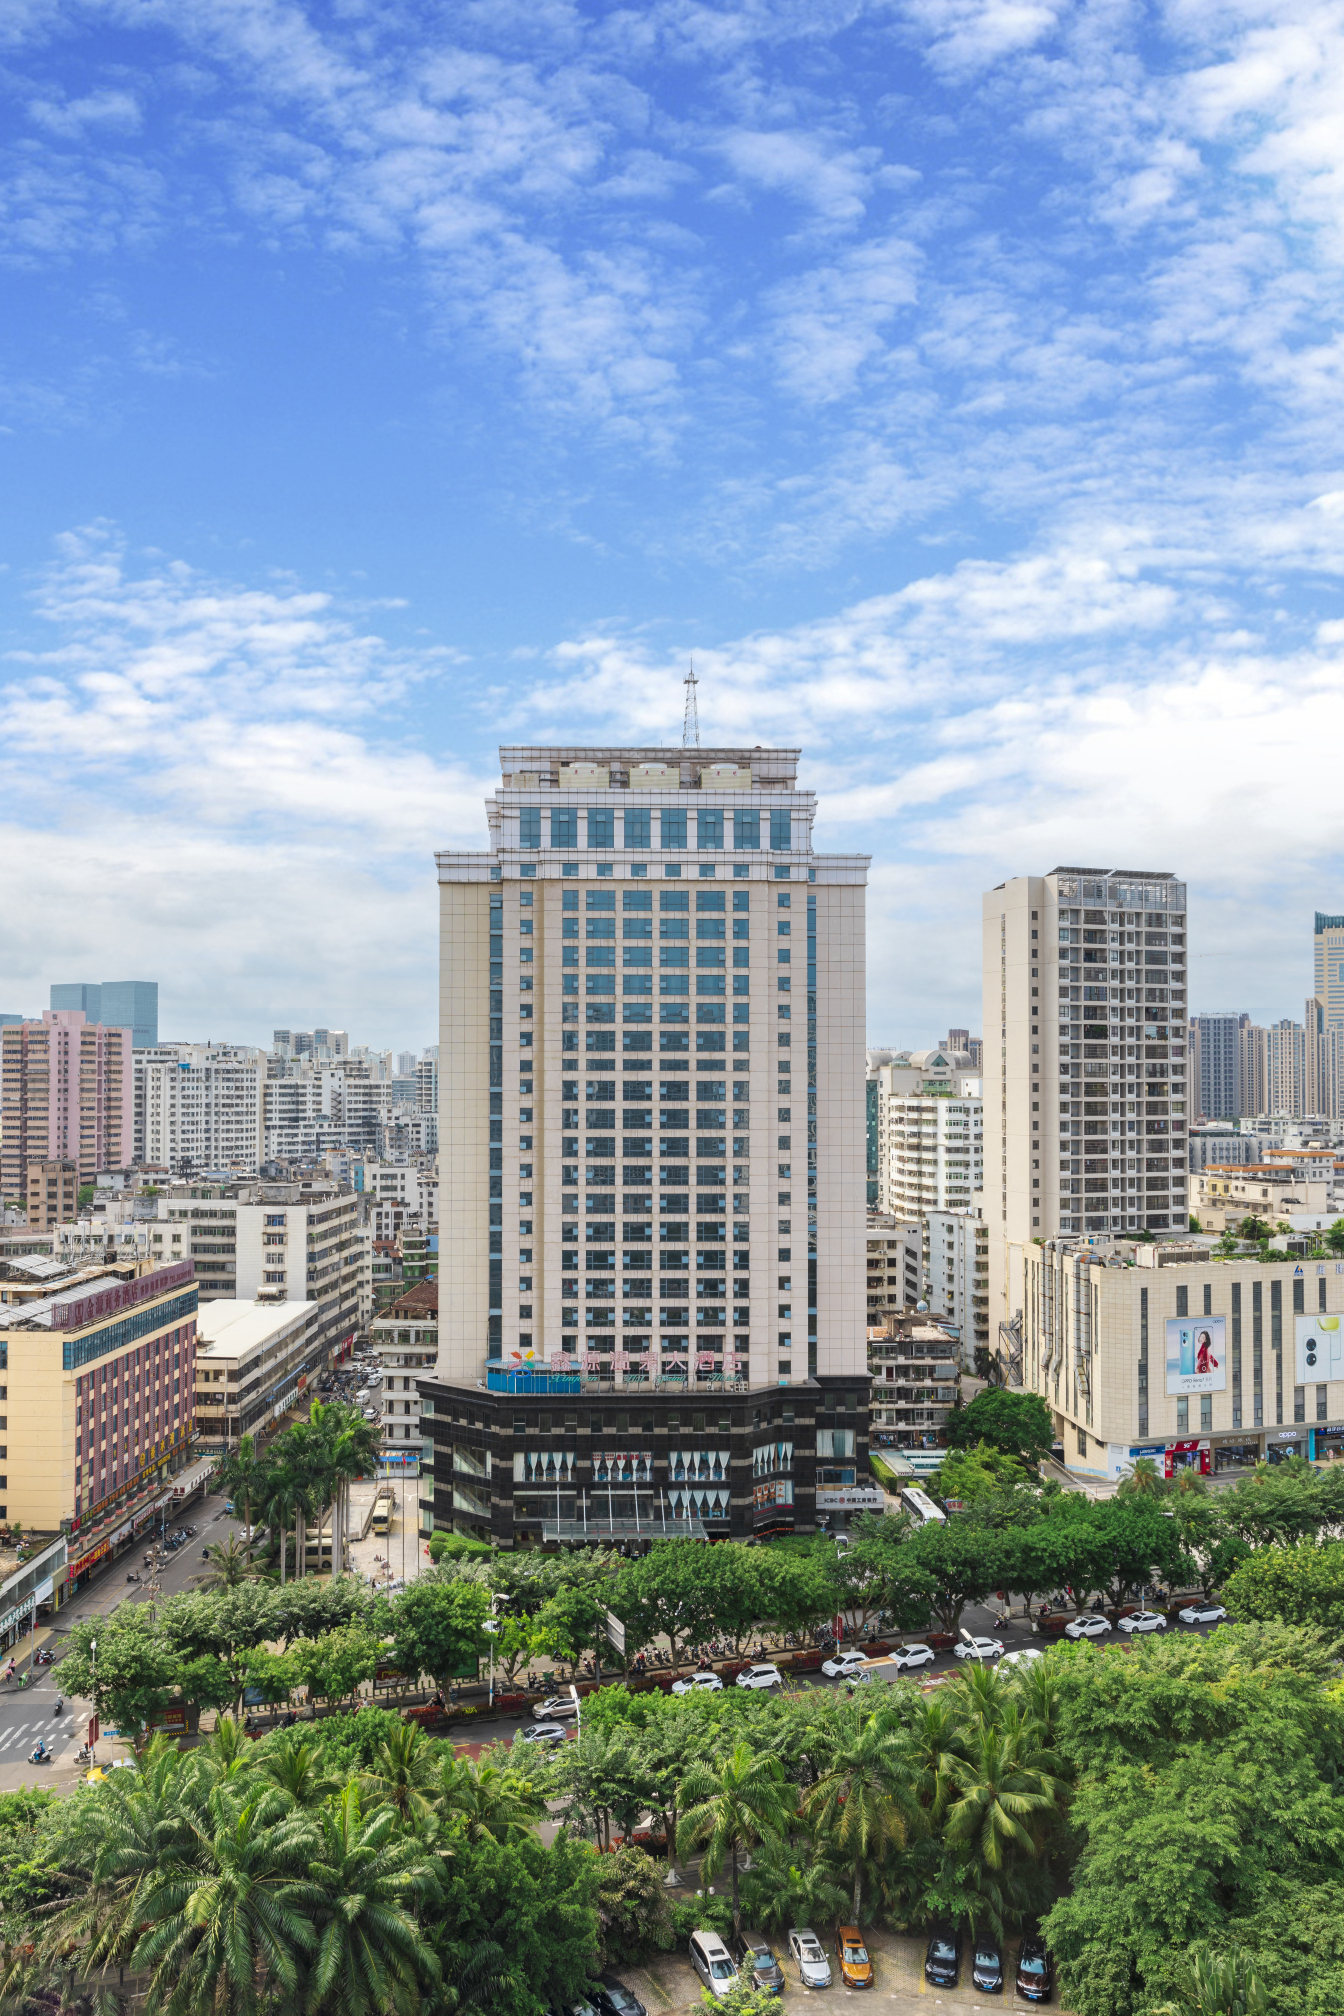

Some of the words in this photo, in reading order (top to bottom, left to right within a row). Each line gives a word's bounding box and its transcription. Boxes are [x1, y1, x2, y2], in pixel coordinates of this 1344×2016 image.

[551, 1350, 743, 1372] 鑫源温泉大酒店
[707, 1373, 743, 1382] Hotel
